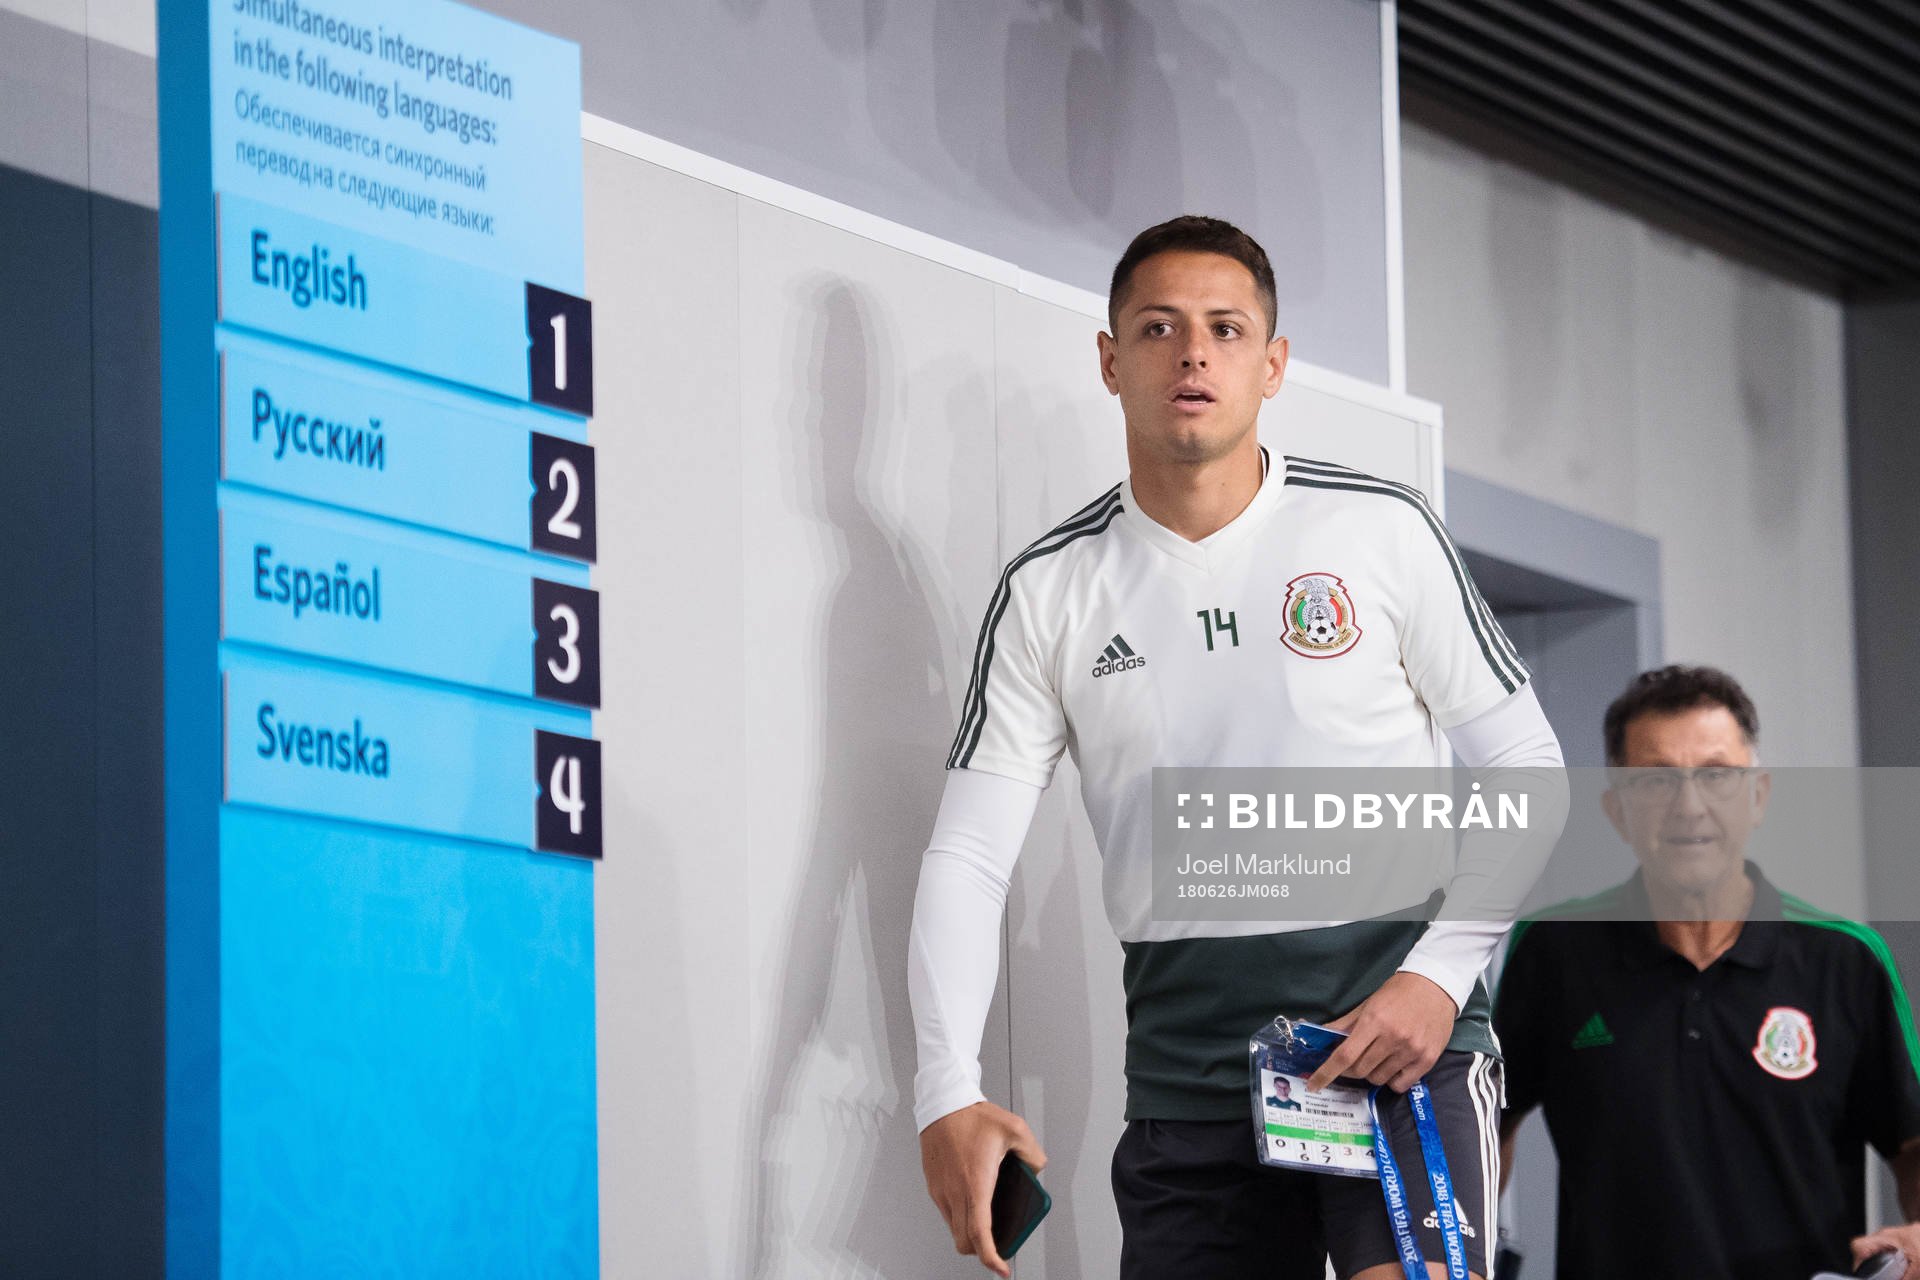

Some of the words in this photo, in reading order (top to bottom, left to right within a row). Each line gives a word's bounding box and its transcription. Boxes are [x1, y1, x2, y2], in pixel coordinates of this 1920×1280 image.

[378, 24, 513, 101] interpretation
[295, 46, 390, 120] following
[393, 79, 498, 146] languages:
[234, 86, 381, 161] Обеспечивается
[384, 141, 487, 193] синхронный
[337, 170, 438, 219] следующие
[441, 201, 495, 236] языки:
[250, 230, 369, 312] English
[550, 313, 568, 392] 1
[252, 389, 386, 473] Русский
[547, 457, 583, 541] 2
[253, 543, 382, 622] Español
[547, 603, 581, 685] 3
[1197, 607, 1239, 652] 14
[1091, 655, 1146, 679] adidas
[255, 703, 391, 779] Svenska
[549, 755, 586, 835] 4
[1275, 1138, 1286, 1148] 0
[1299, 1142, 1306, 1151] 1
[1320, 1144, 1330, 1154] 2
[1343, 1147, 1353, 1157] 3
[1300, 1153, 1310, 1161] 6
[1378, 1140, 1391, 1165] CUP
[1383, 1165, 1403, 1209] WORLD
[1432, 1172, 1449, 1202] 2018
[1439, 1202, 1455, 1229] FIFA
[1394, 1209, 1410, 1236] FIFA
[1400, 1235, 1418, 1264] 2018
[1445, 1229, 1465, 1279] WORLD
